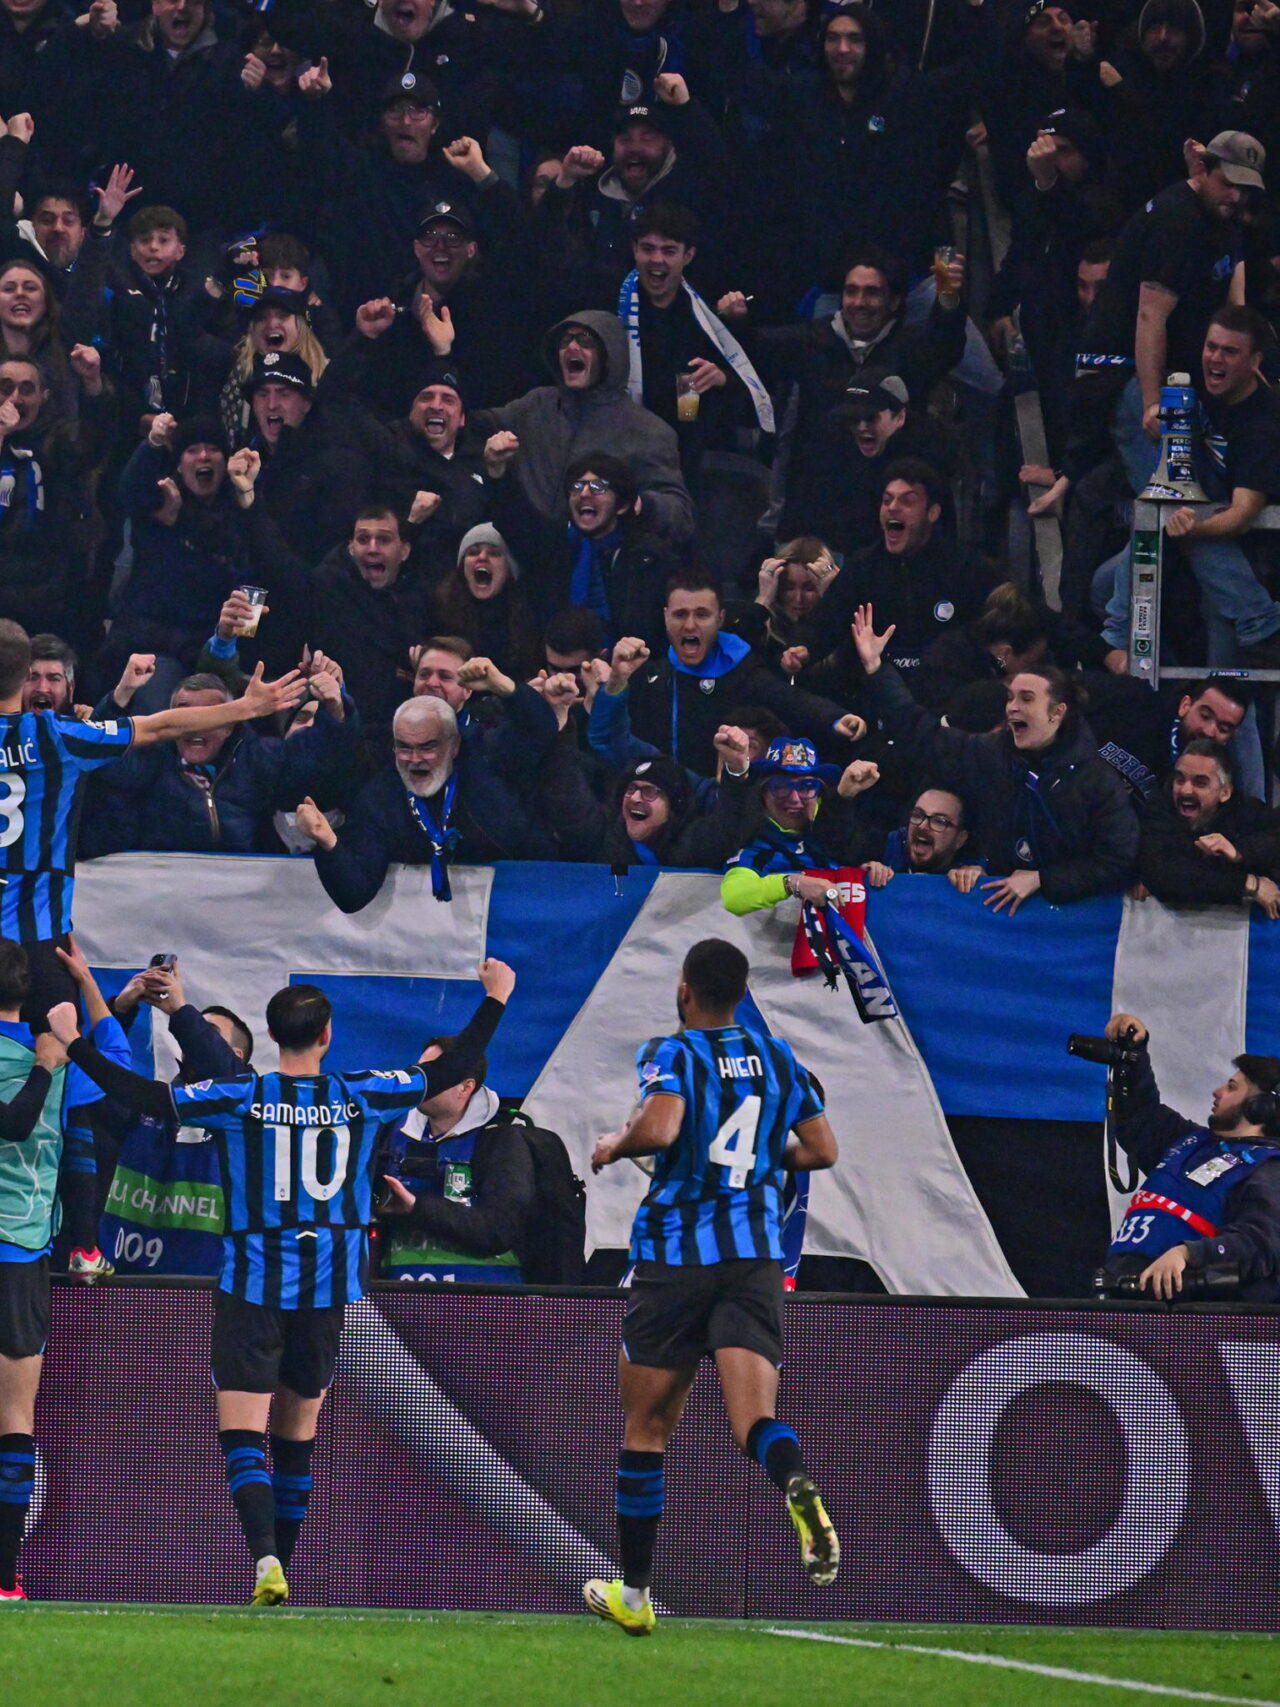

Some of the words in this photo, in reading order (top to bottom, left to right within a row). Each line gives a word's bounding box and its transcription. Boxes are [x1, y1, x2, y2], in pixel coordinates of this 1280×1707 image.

[630, 106, 649, 116] VANS
[717, 1055, 762, 1079] HIEN
[250, 1097, 359, 1125] SAMARDŽIĆ
[708, 1095, 760, 1189] 4
[263, 1124, 350, 1202] 10
[130, 1188, 220, 1220] CHANNEL
[114, 1226, 164, 1268] 009
